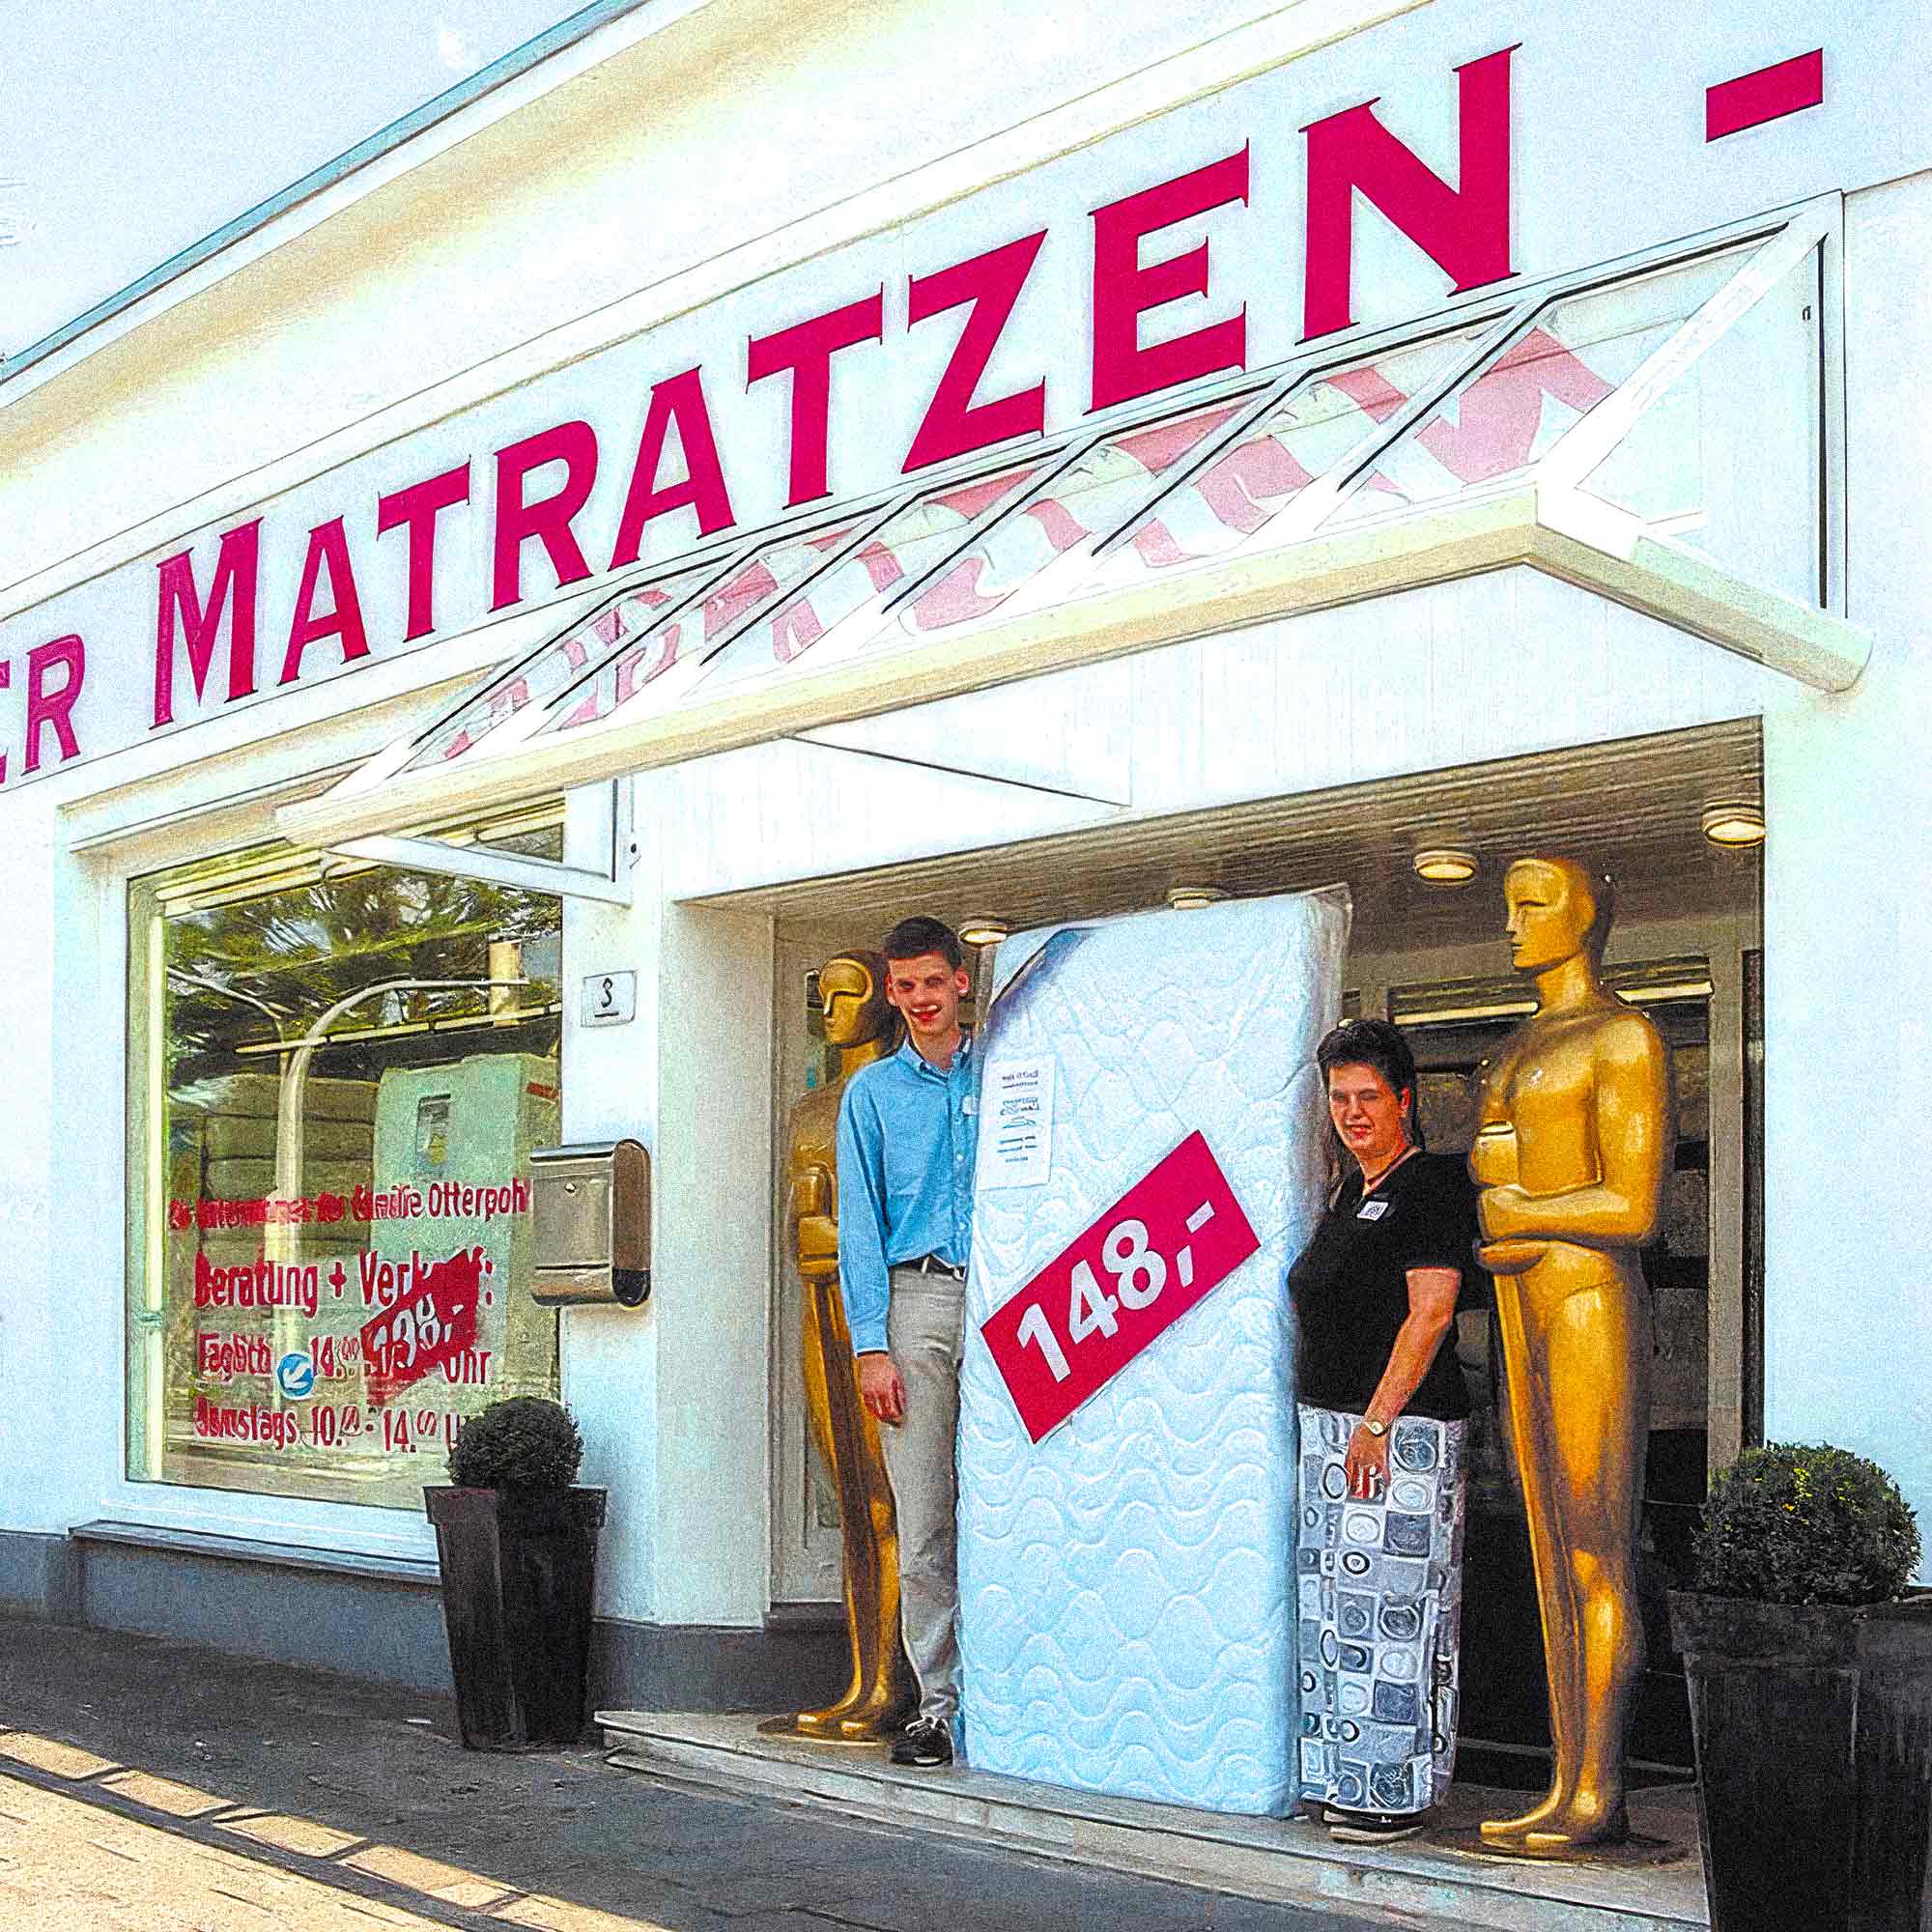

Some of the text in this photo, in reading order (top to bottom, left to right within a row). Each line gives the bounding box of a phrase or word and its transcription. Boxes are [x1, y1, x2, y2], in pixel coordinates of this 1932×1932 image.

[0, 634, 85, 784] R
[152, 43, 1523, 730] MATRATZEN
[1016, 1199, 1216, 1383] 148,-
